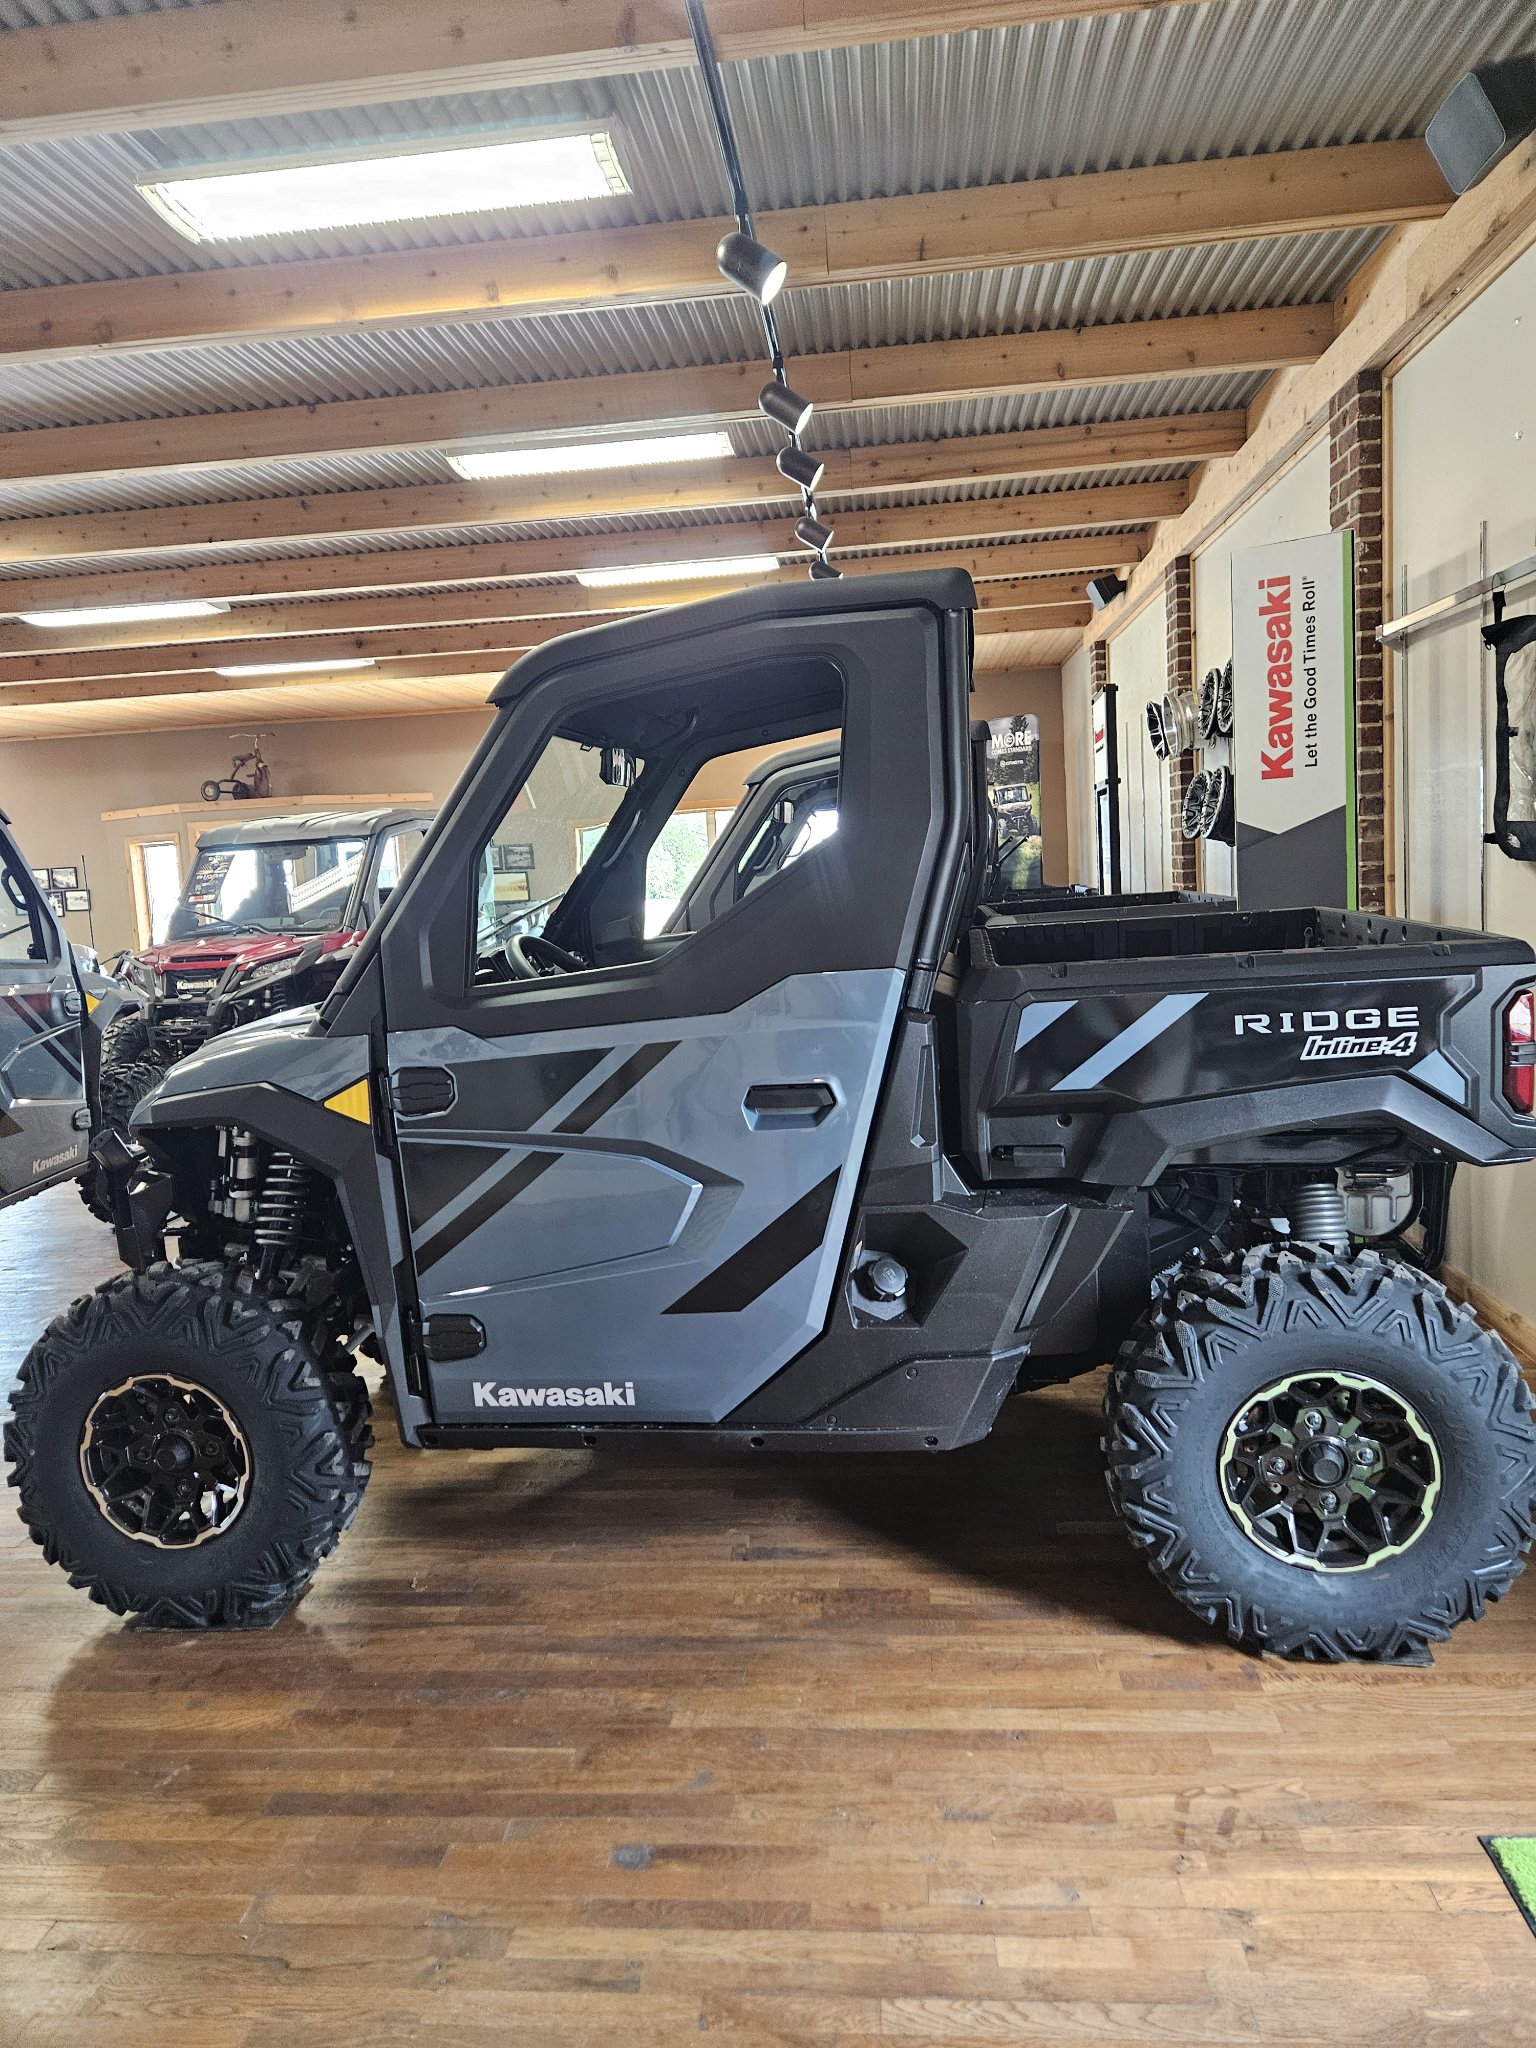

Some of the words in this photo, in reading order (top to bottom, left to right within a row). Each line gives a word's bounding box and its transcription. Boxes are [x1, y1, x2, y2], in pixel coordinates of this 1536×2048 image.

[1303, 615, 1316, 664] Times
[1258, 575, 1294, 780] Kawasaki
[1303, 667, 1317, 708] Good
[991, 729, 1032, 750] MORE
[1304, 713, 1317, 739] the
[1304, 743, 1318, 767] Let
[176, 979, 217, 990] Kawasaki
[1234, 1006, 1420, 1035] RIDGE
[1300, 1031, 1418, 1061] Inline-4
[32, 1144, 78, 1175] Kawasaki
[472, 1381, 636, 1407] Kawasaki
